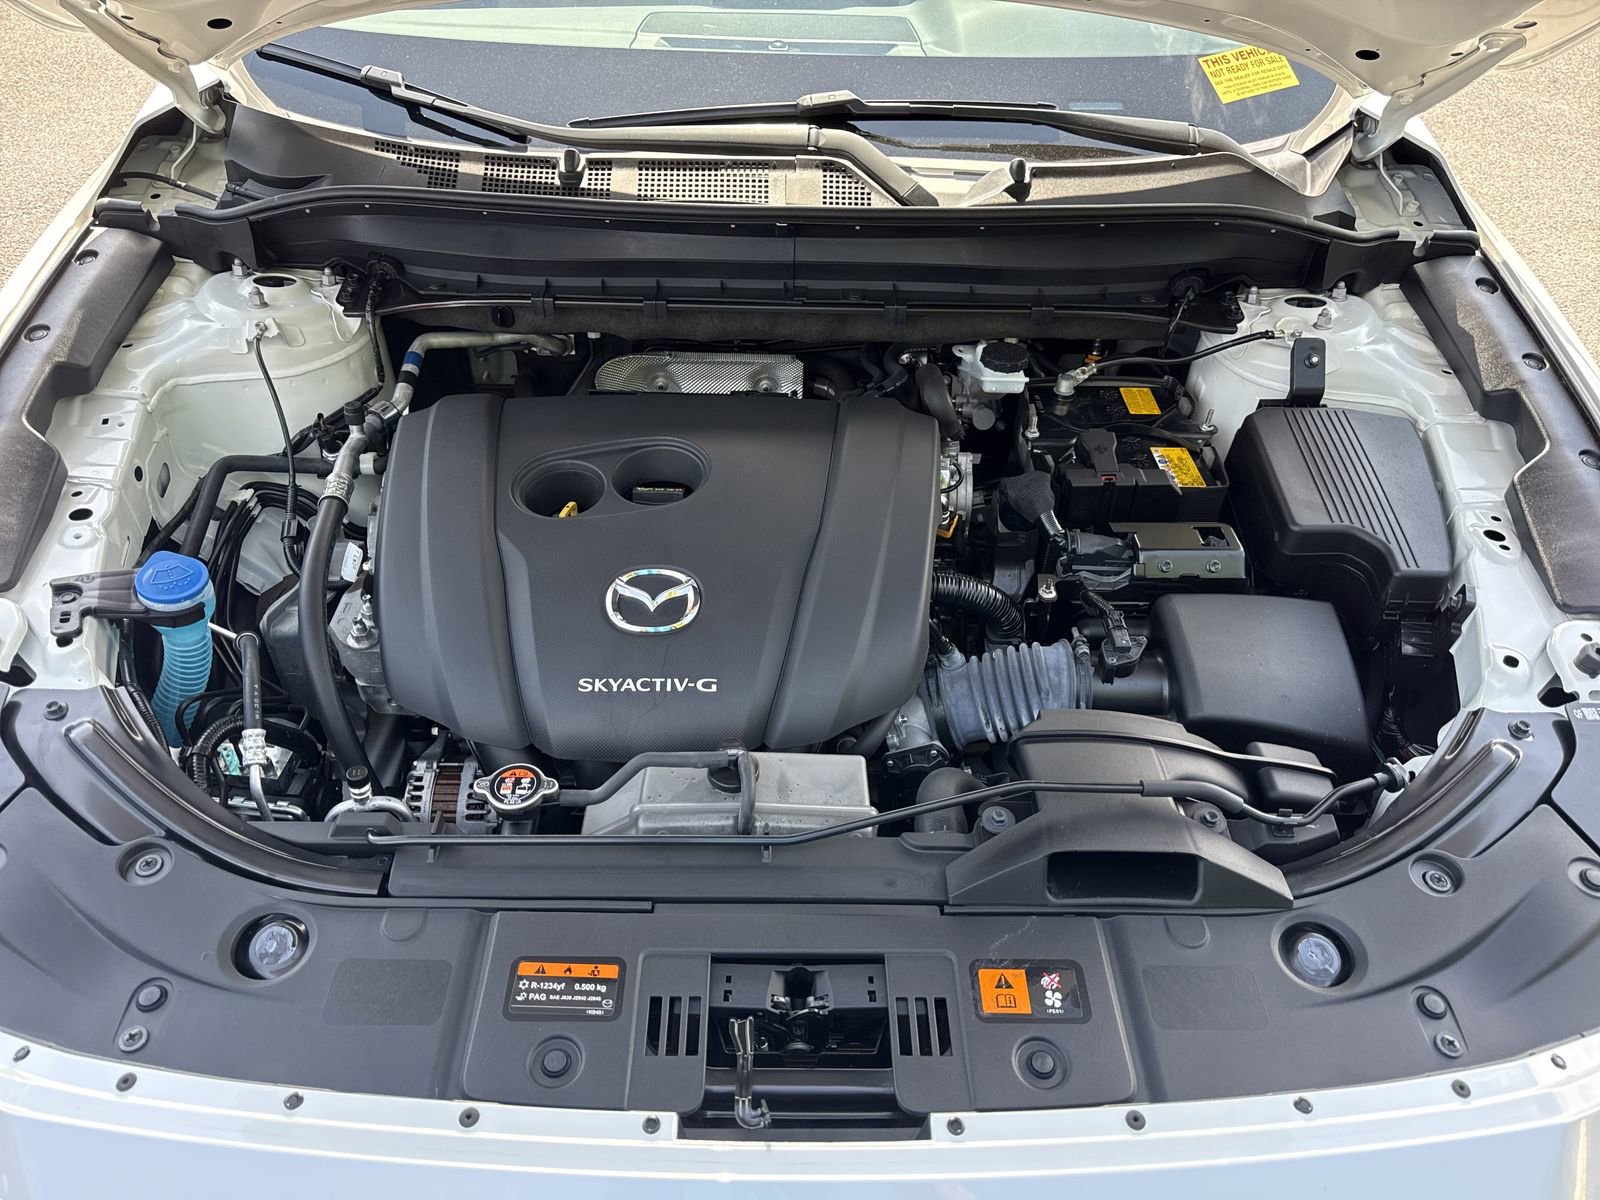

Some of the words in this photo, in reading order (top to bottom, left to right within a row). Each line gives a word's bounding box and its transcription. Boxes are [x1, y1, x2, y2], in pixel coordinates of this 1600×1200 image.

[1202, 55, 1231, 69] THIS
[1231, 48, 1270, 63] VEHIC
[1210, 68, 1226, 79] NOT
[1226, 62, 1250, 74] READY
[1250, 59, 1266, 69] FOR
[1265, 55, 1284, 65] SALE
[577, 677, 718, 693] SKYACTIV-G
[530, 981, 565, 991] R-1234yf
[574, 983, 595, 991] 0.500
[596, 983, 607, 992] kg
[528, 993, 547, 1001] PAG
